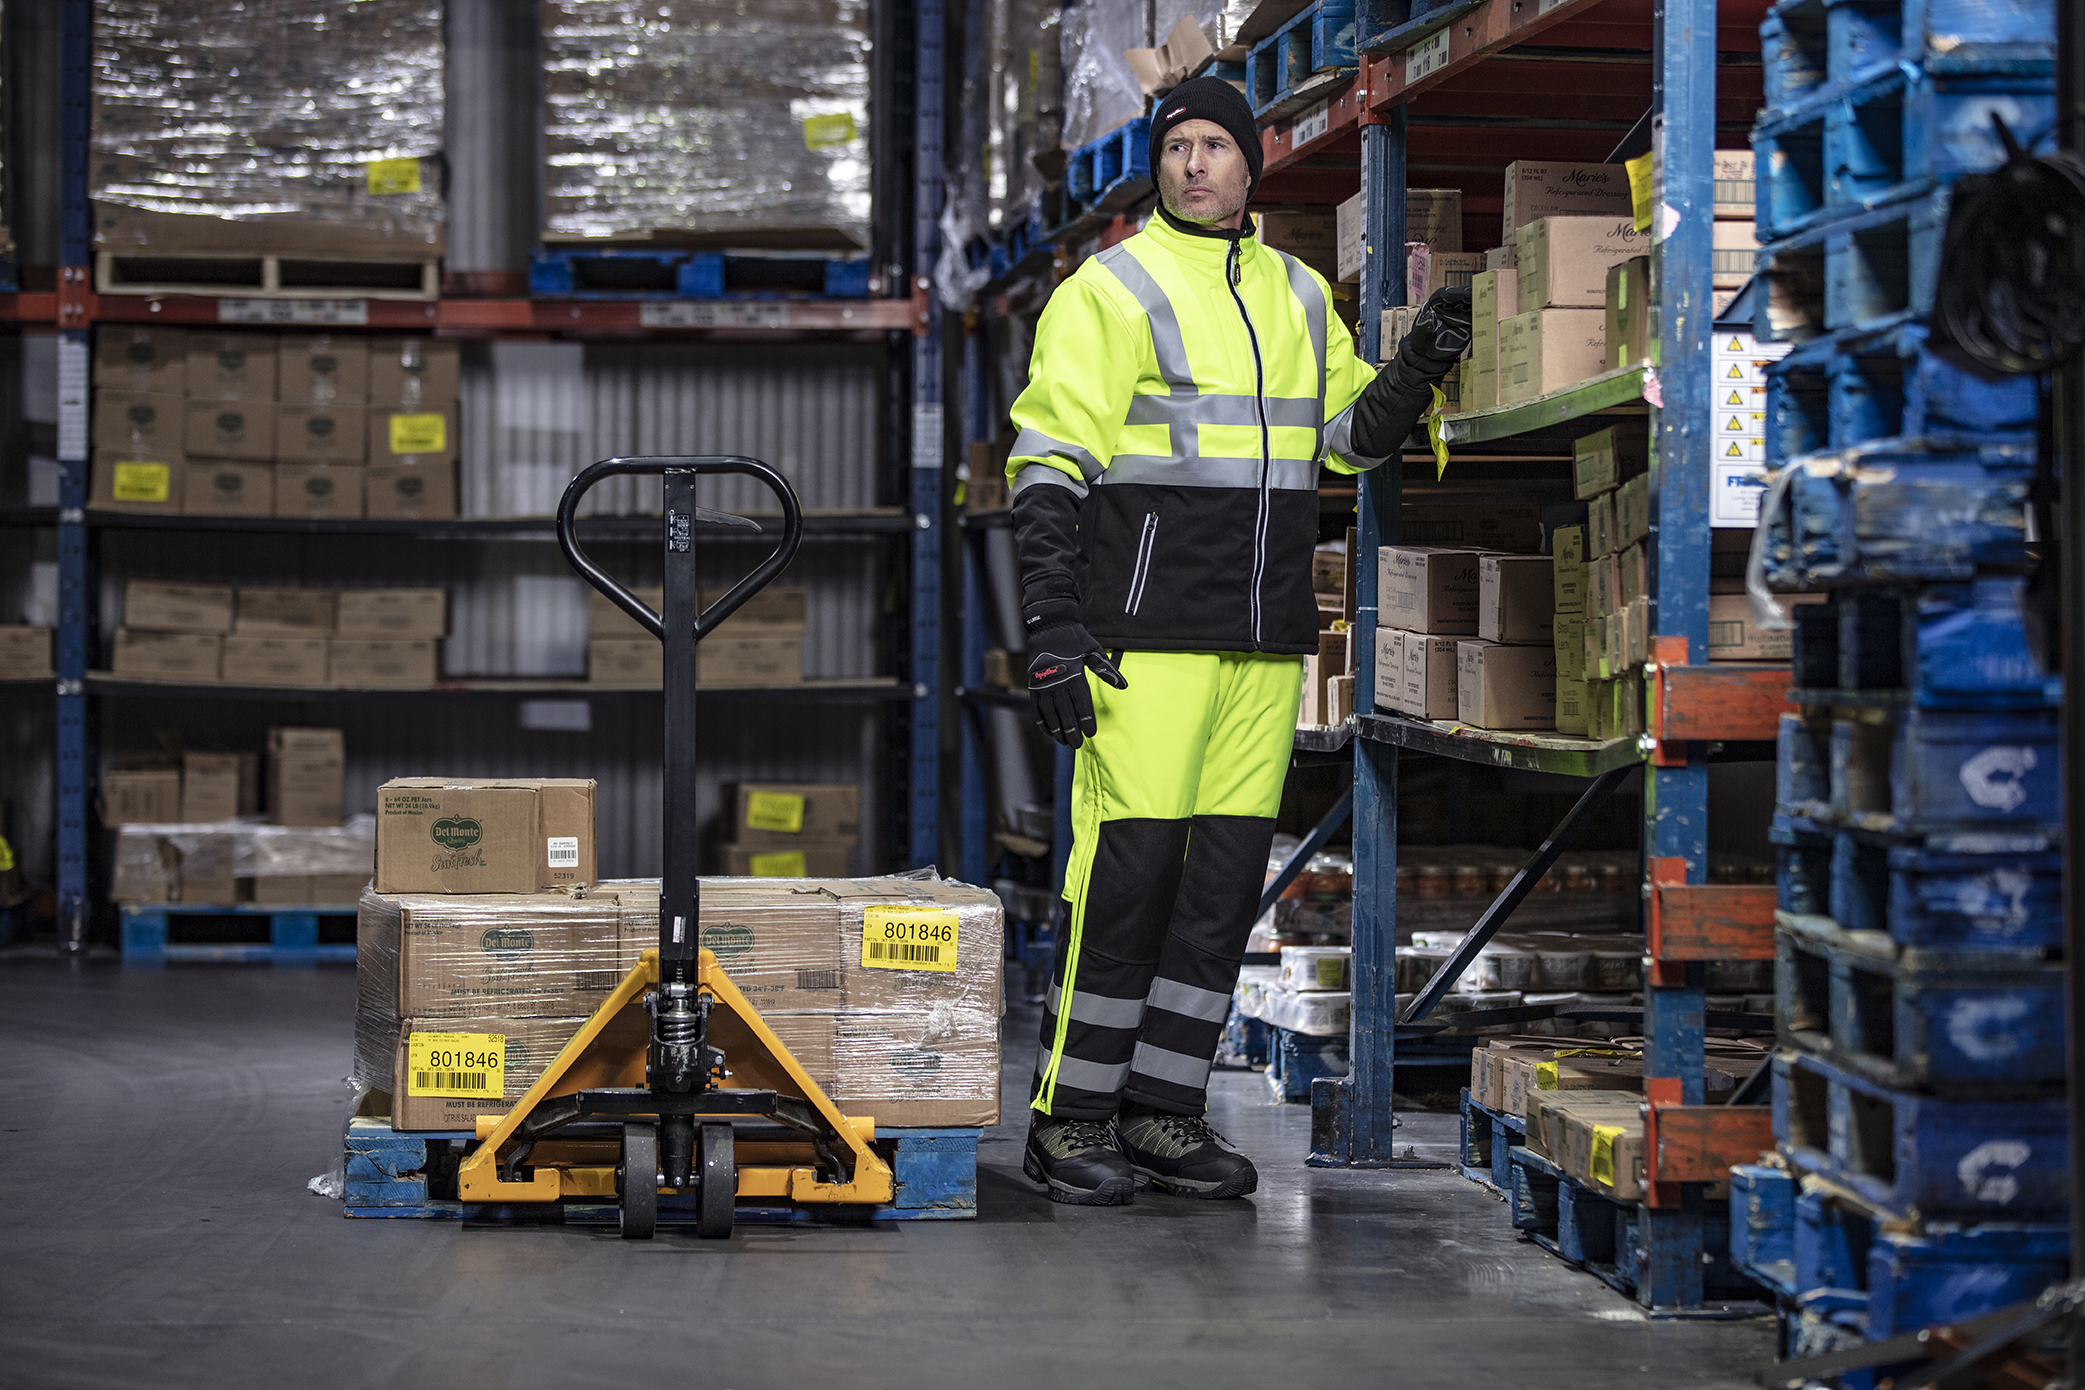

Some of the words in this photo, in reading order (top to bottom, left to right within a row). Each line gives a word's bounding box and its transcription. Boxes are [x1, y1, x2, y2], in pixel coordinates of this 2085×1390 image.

[1562, 169, 1608, 188] Marie's
[1544, 186, 1595, 198] Refrigerated
[1595, 188, 1629, 200] Dressing
[1594, 245, 1642, 256] Refrigerated
[435, 827, 450, 837] Del
[450, 827, 479, 837] Monte
[884, 922, 952, 941] 801846
[485, 937, 499, 948] Del
[500, 937, 531, 948] Monte
[488, 1034, 504, 1043] 52518
[430, 1051, 498, 1068] 801846
